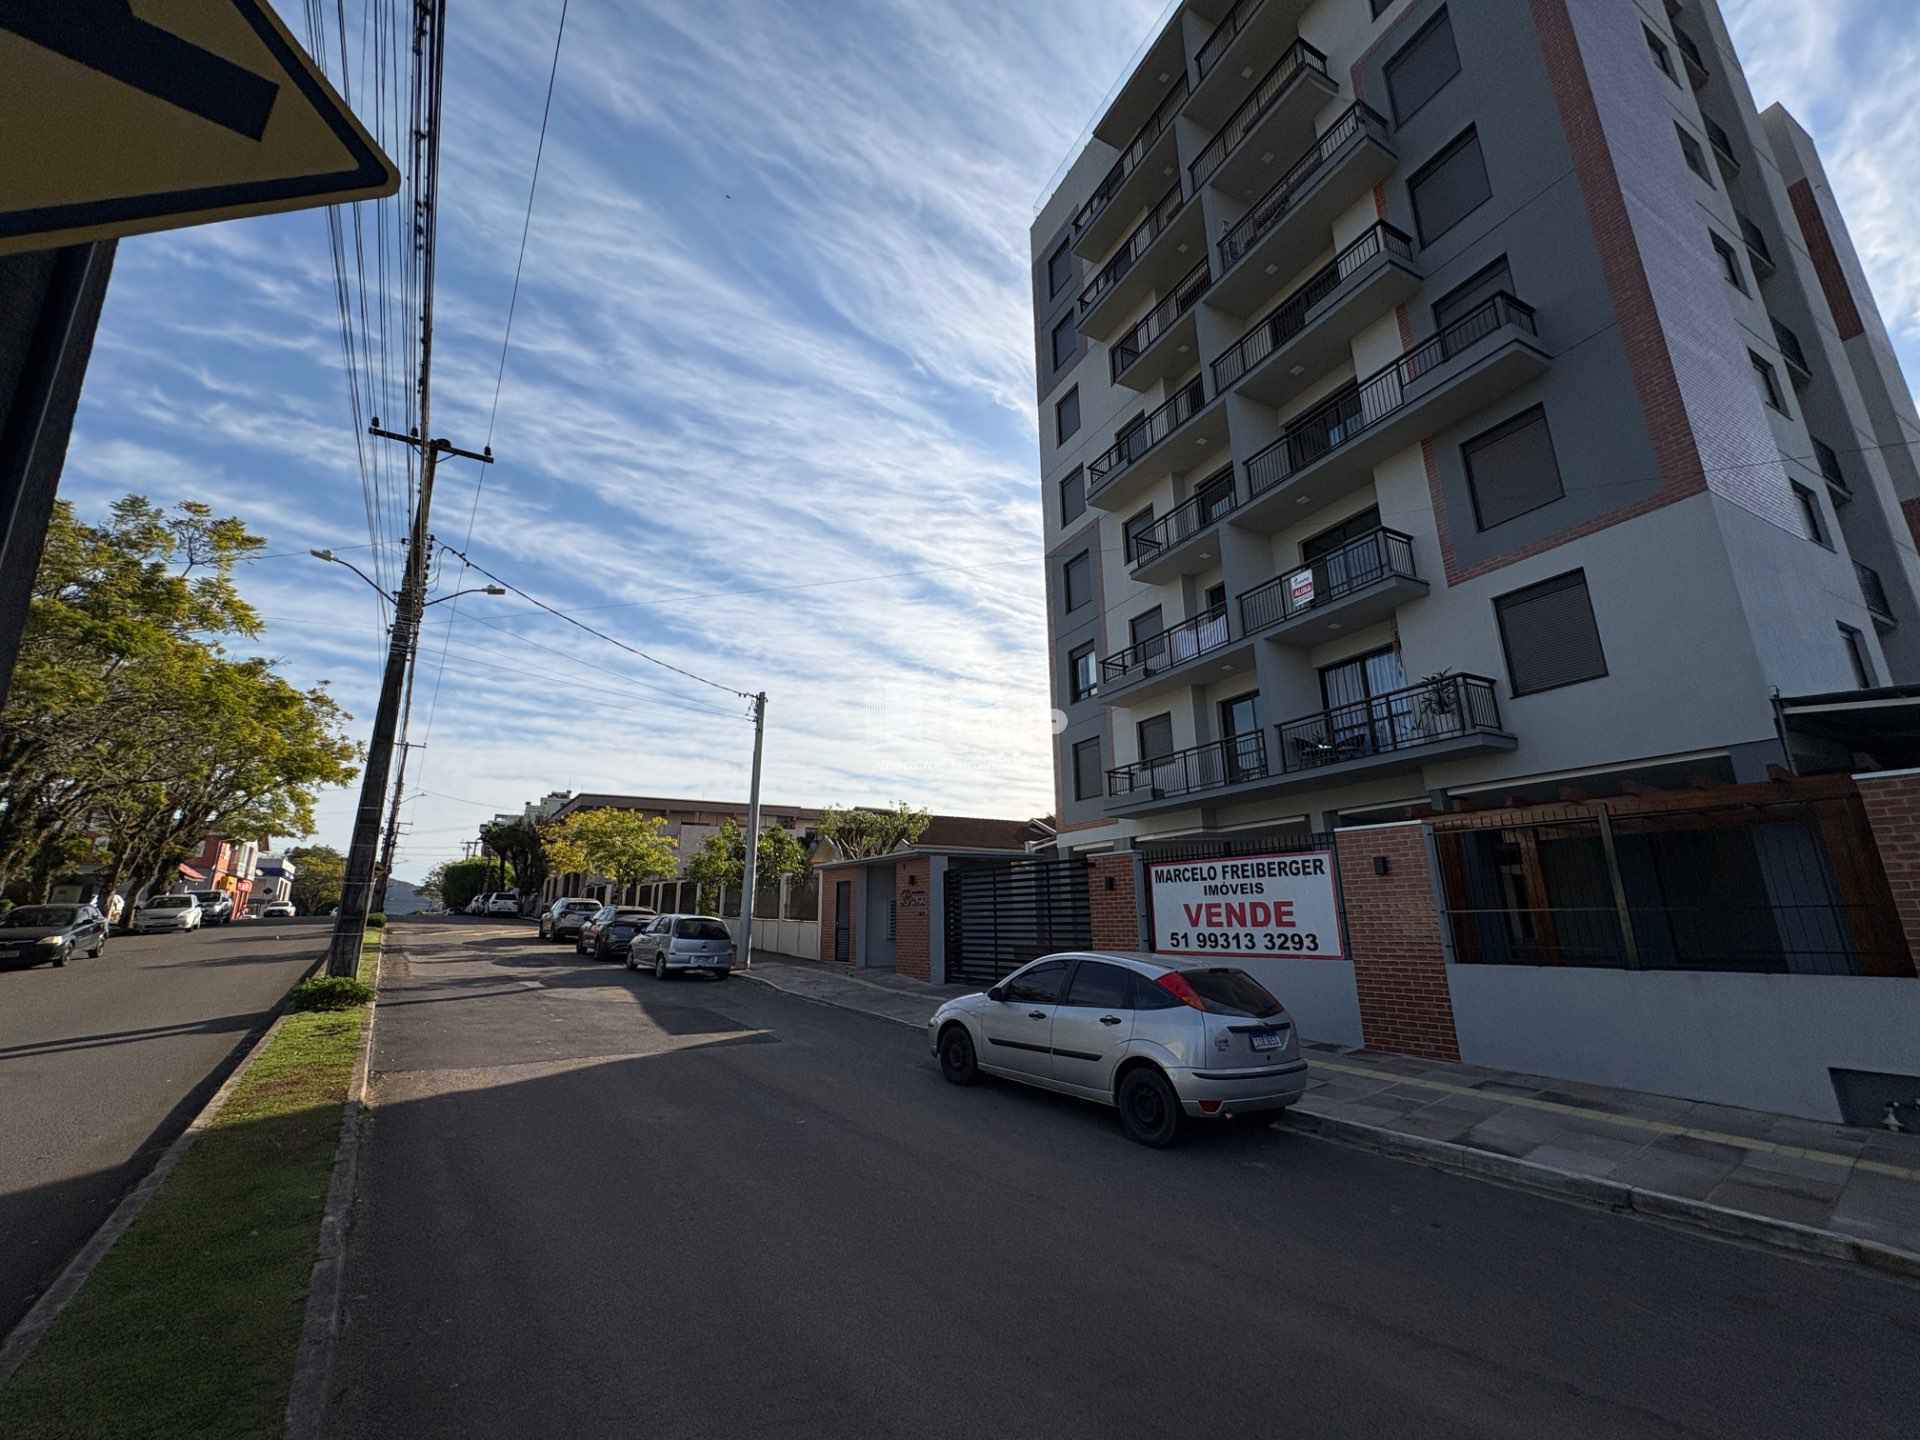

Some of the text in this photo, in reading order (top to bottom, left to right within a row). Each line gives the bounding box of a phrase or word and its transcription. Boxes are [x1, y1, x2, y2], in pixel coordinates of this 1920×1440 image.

[1155, 858, 1325, 883] MARCELO FREIBERGER
[1203, 882, 1264, 896] IMÓVEIS
[1183, 901, 1296, 928] VENDE
[1170, 932, 1319, 951] 51 99313 3293
